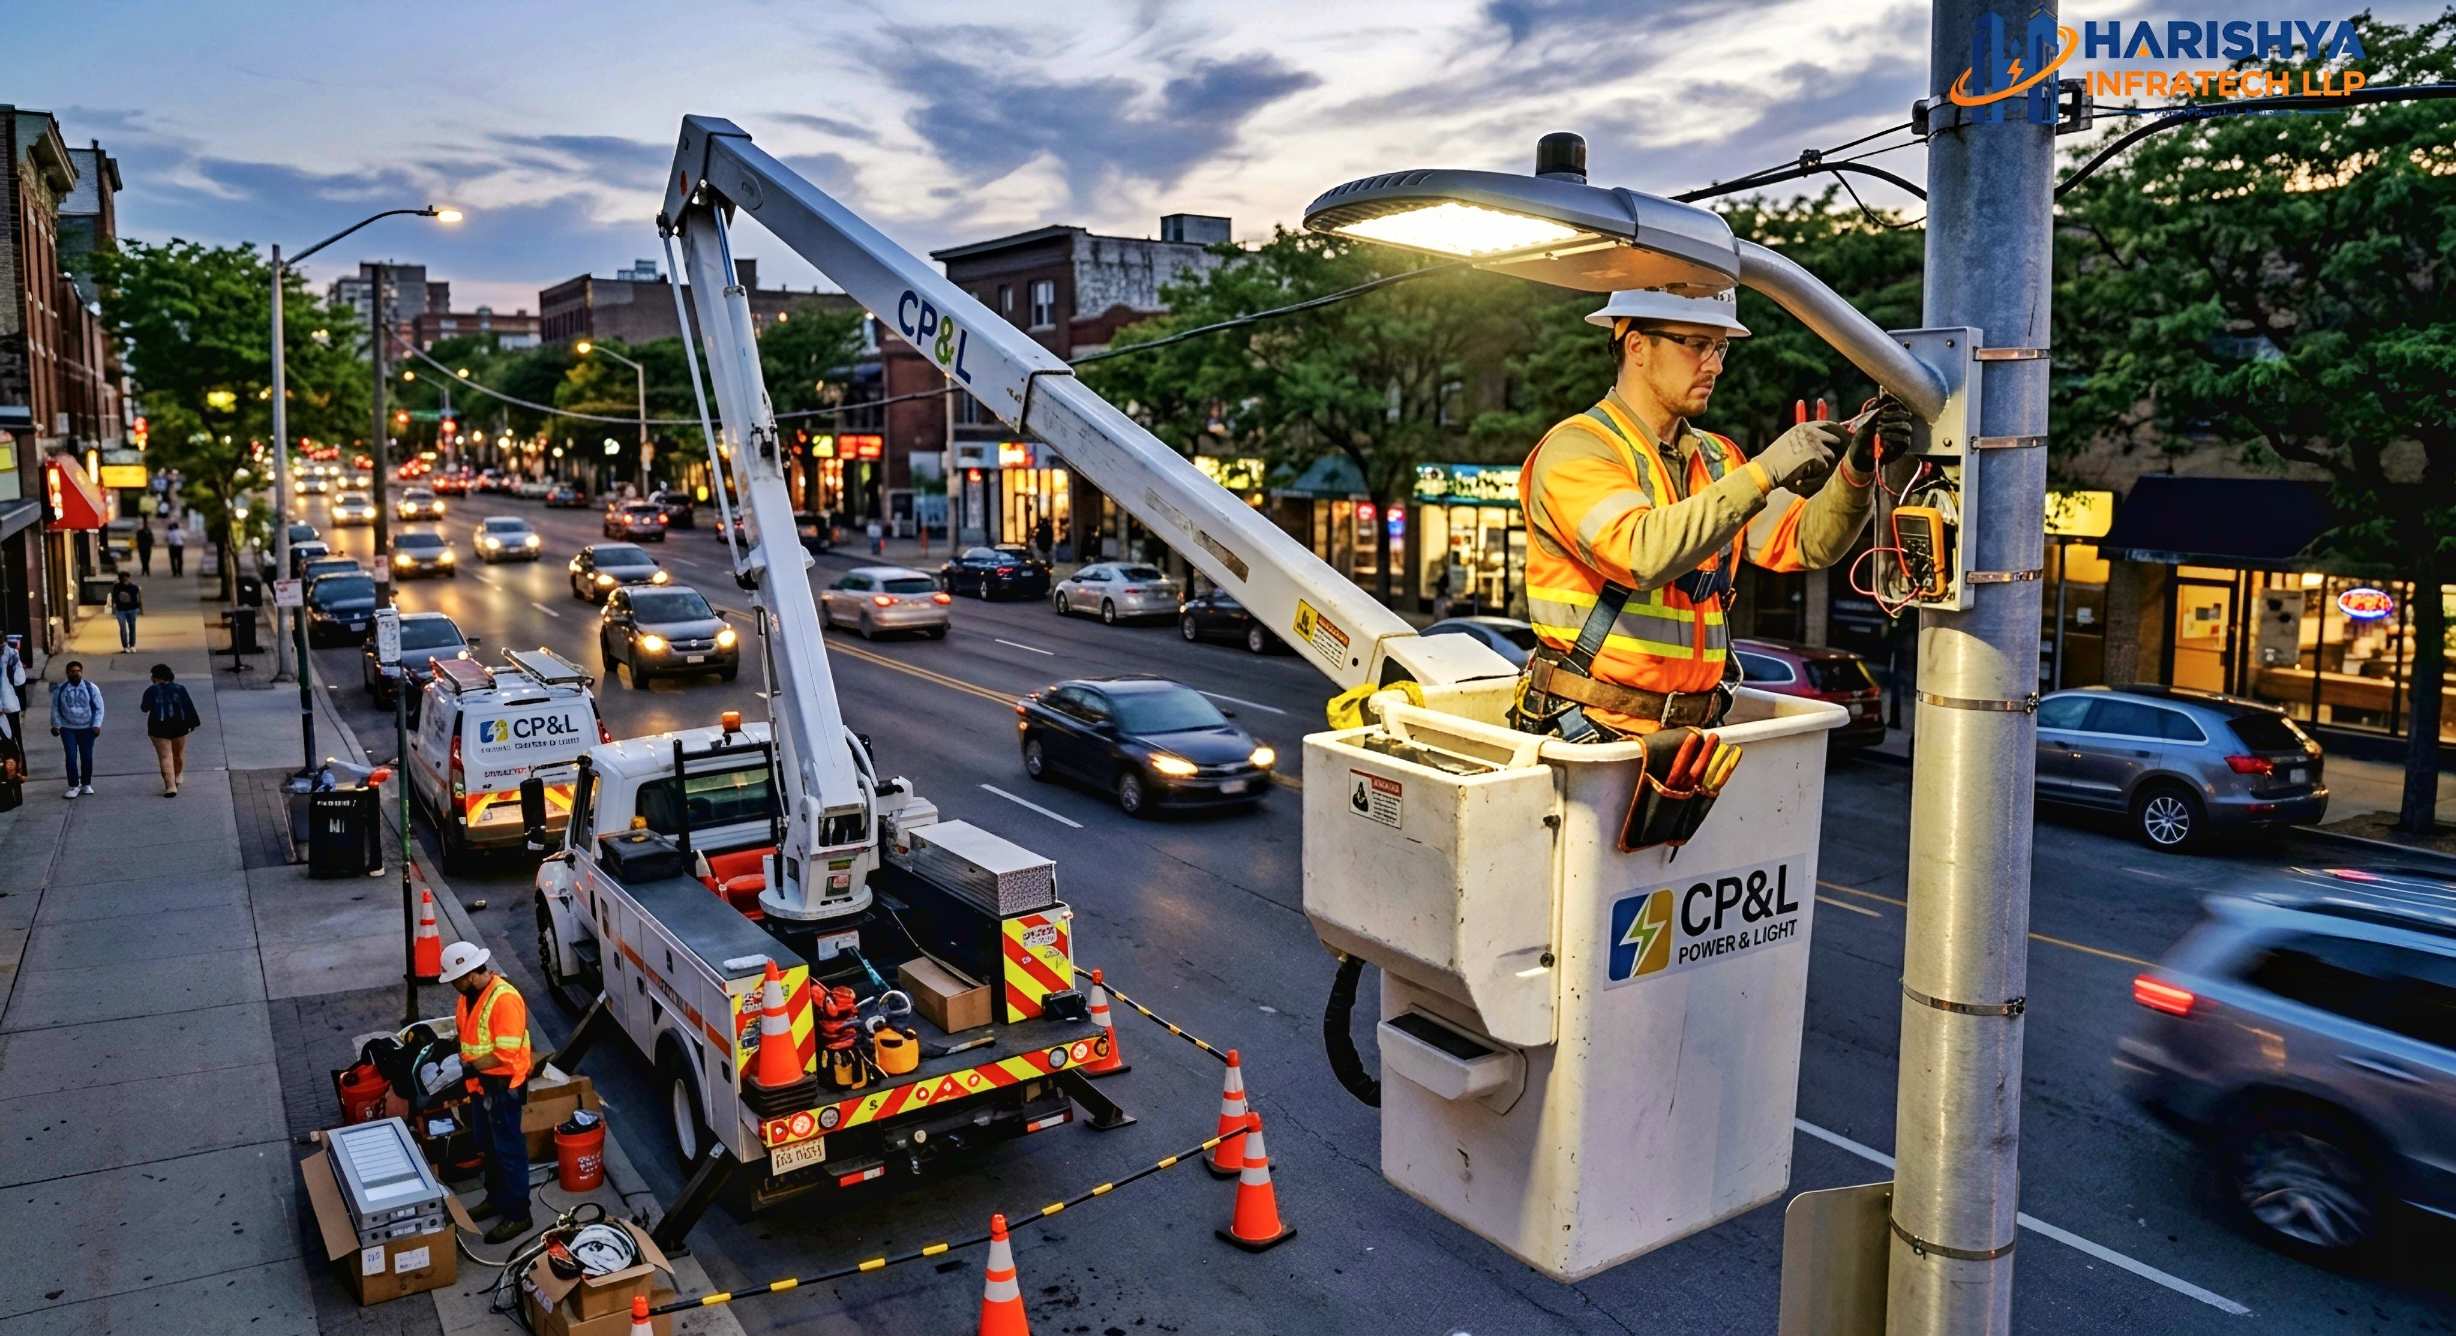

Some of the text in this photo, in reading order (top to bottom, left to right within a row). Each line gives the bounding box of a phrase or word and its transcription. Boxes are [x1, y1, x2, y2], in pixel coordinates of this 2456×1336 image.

[898, 290, 971, 384] CP&L
[513, 714, 579, 738] CP&L
[1681, 864, 1799, 937] CP&L
[1678, 919, 1797, 964] POWER & LIGHT
